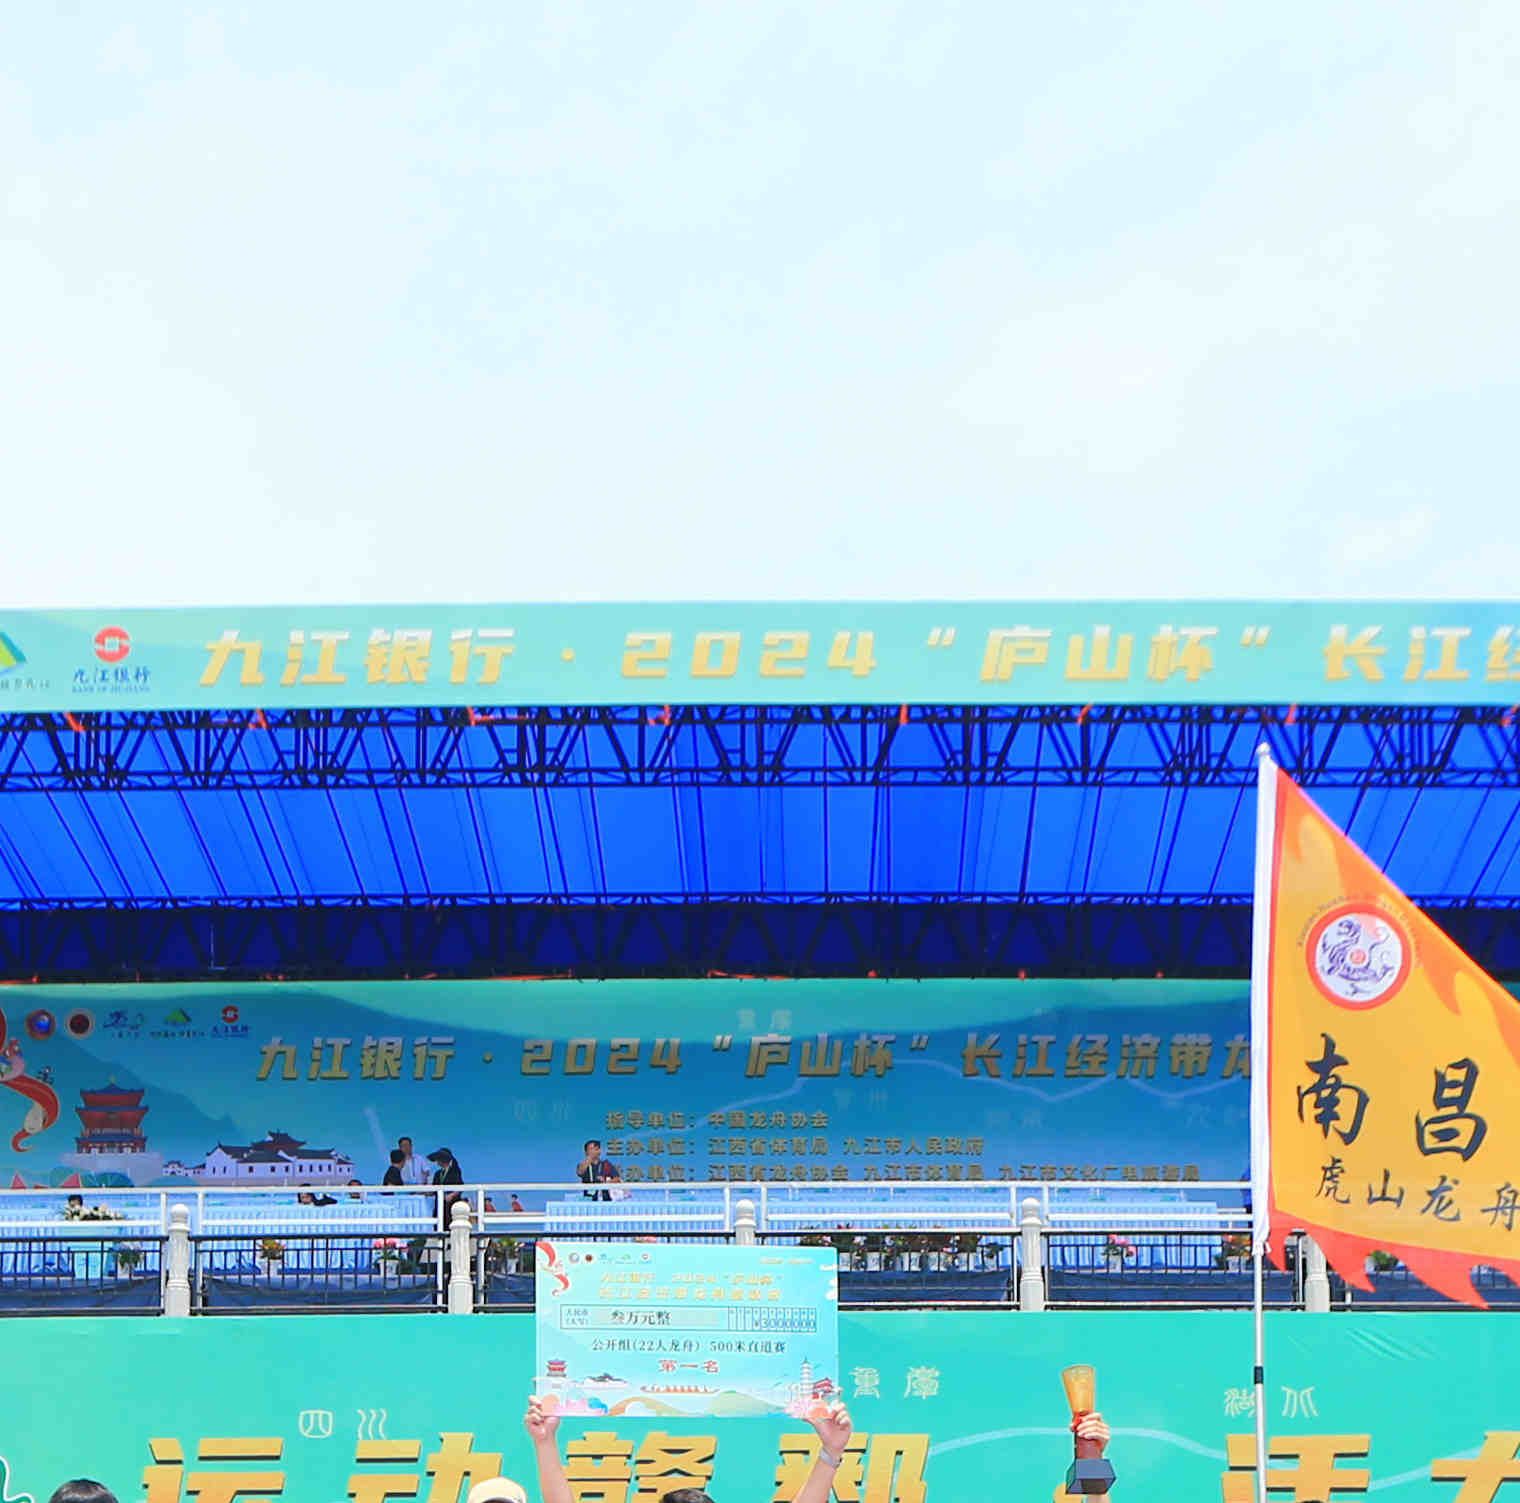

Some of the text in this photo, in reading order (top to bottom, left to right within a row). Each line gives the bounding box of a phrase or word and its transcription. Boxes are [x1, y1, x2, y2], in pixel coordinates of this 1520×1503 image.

[199, 628, 516, 686] 九江银行
[620, 629, 876, 681] 2024
[255, 1036, 456, 1081] 九江银行
[520, 1036, 682, 1077] 2024
[611, 1310, 672, 1326] 叁万元整
[658, 1359, 720, 1374] 第一名
